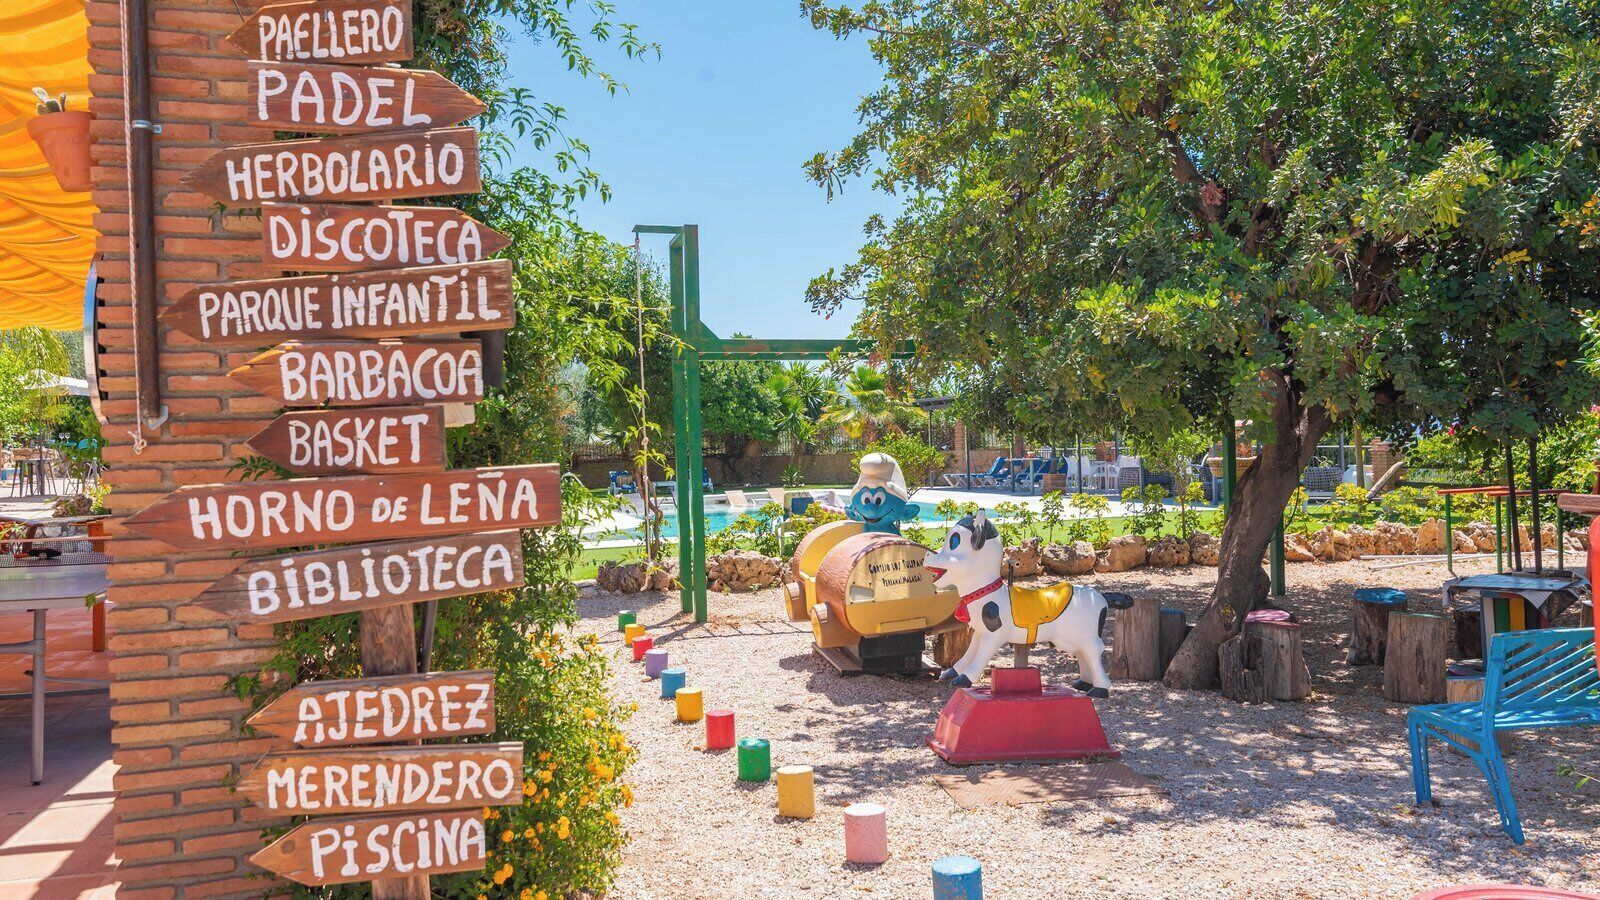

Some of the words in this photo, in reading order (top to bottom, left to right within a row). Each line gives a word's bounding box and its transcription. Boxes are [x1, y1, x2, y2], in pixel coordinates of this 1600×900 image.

[259, 6, 404, 61] PAELLERO
[257, 69, 432, 126] PADEL
[200, 287, 322, 338] PARQUE
[279, 349, 483, 401] BARBACOA
[288, 414, 428, 467] BASKET
[189, 489, 354, 539] HORNO
[372, 497, 407, 523] DE
[420, 472, 538, 524] LEÑA
[294, 684, 489, 743] AJEDREZ
[268, 759, 514, 809] MERENDERO
